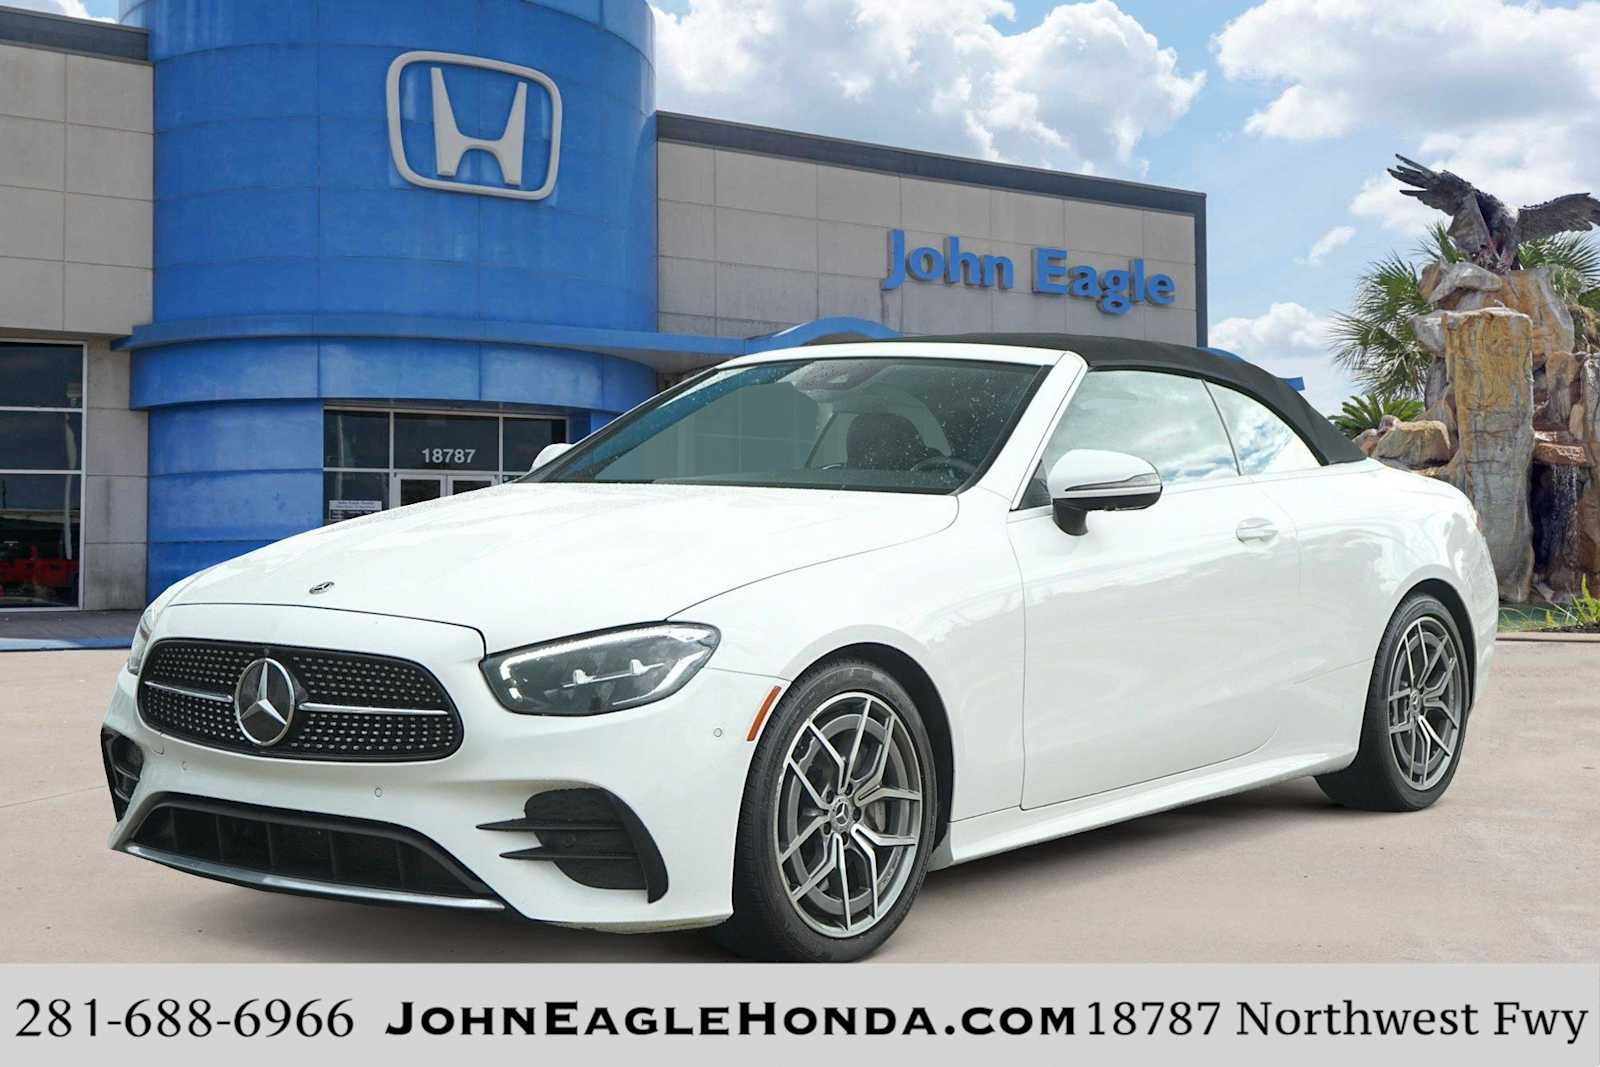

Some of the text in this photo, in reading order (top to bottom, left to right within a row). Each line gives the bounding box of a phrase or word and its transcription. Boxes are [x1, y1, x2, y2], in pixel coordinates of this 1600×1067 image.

[881, 229, 1176, 316] John Eagle
[421, 448, 476, 464] 18787
